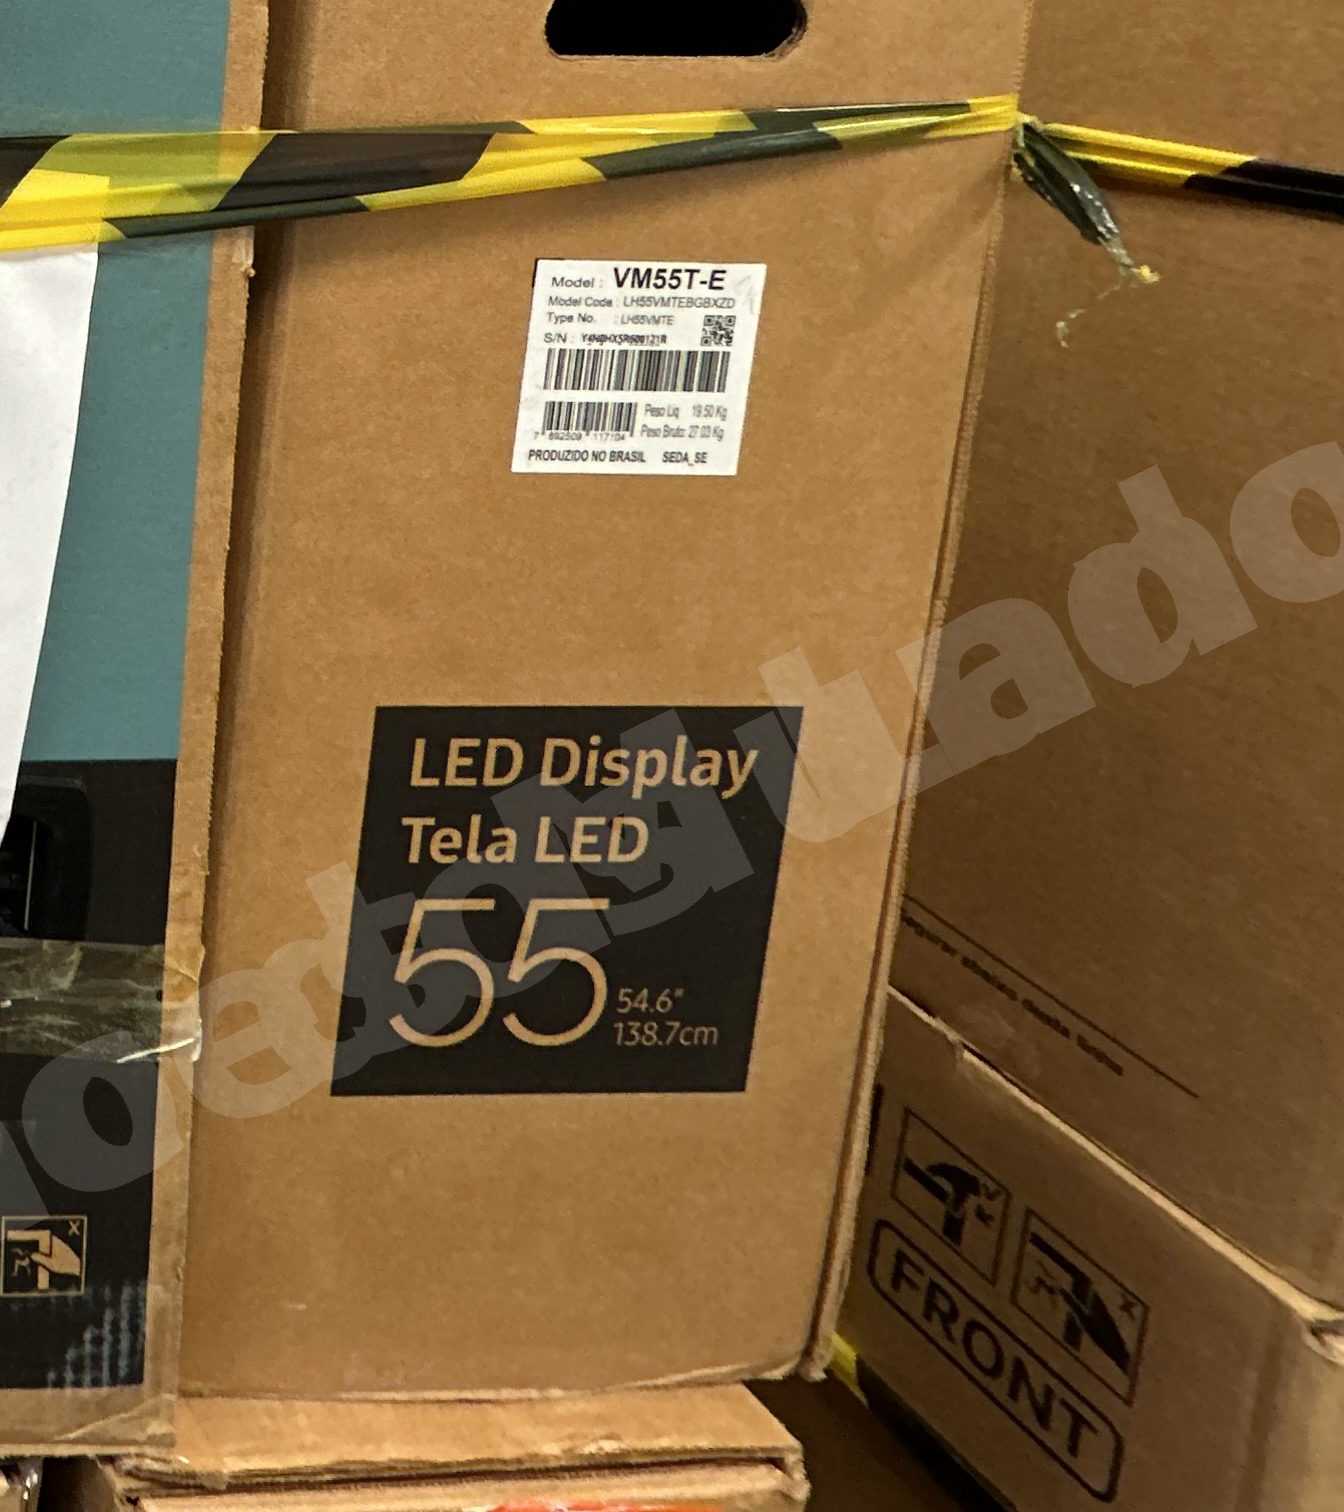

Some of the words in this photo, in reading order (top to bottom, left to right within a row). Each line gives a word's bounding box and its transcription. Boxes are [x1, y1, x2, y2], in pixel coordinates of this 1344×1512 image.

[552, 277, 595, 288] Model
[613, 267, 726, 290] VM55T-E
[548, 297, 582, 307] Model
[585, 297, 613, 308] Code
[547, 312, 573, 324] Type
[544, 333, 567, 343] S/N
[528, 449, 589, 462] PRODUZIDO
[592, 451, 606, 462] NO
[609, 451, 646, 463] BRASIL
[410, 737, 524, 787] LED
[539, 735, 759, 800] Display
[401, 815, 518, 864] Tela
[534, 816, 650, 864] LED
[389, 898, 610, 1047] 55
[613, 1021, 718, 1047] 138.7cm
[889, 1248, 1099, 1458] FRONT
